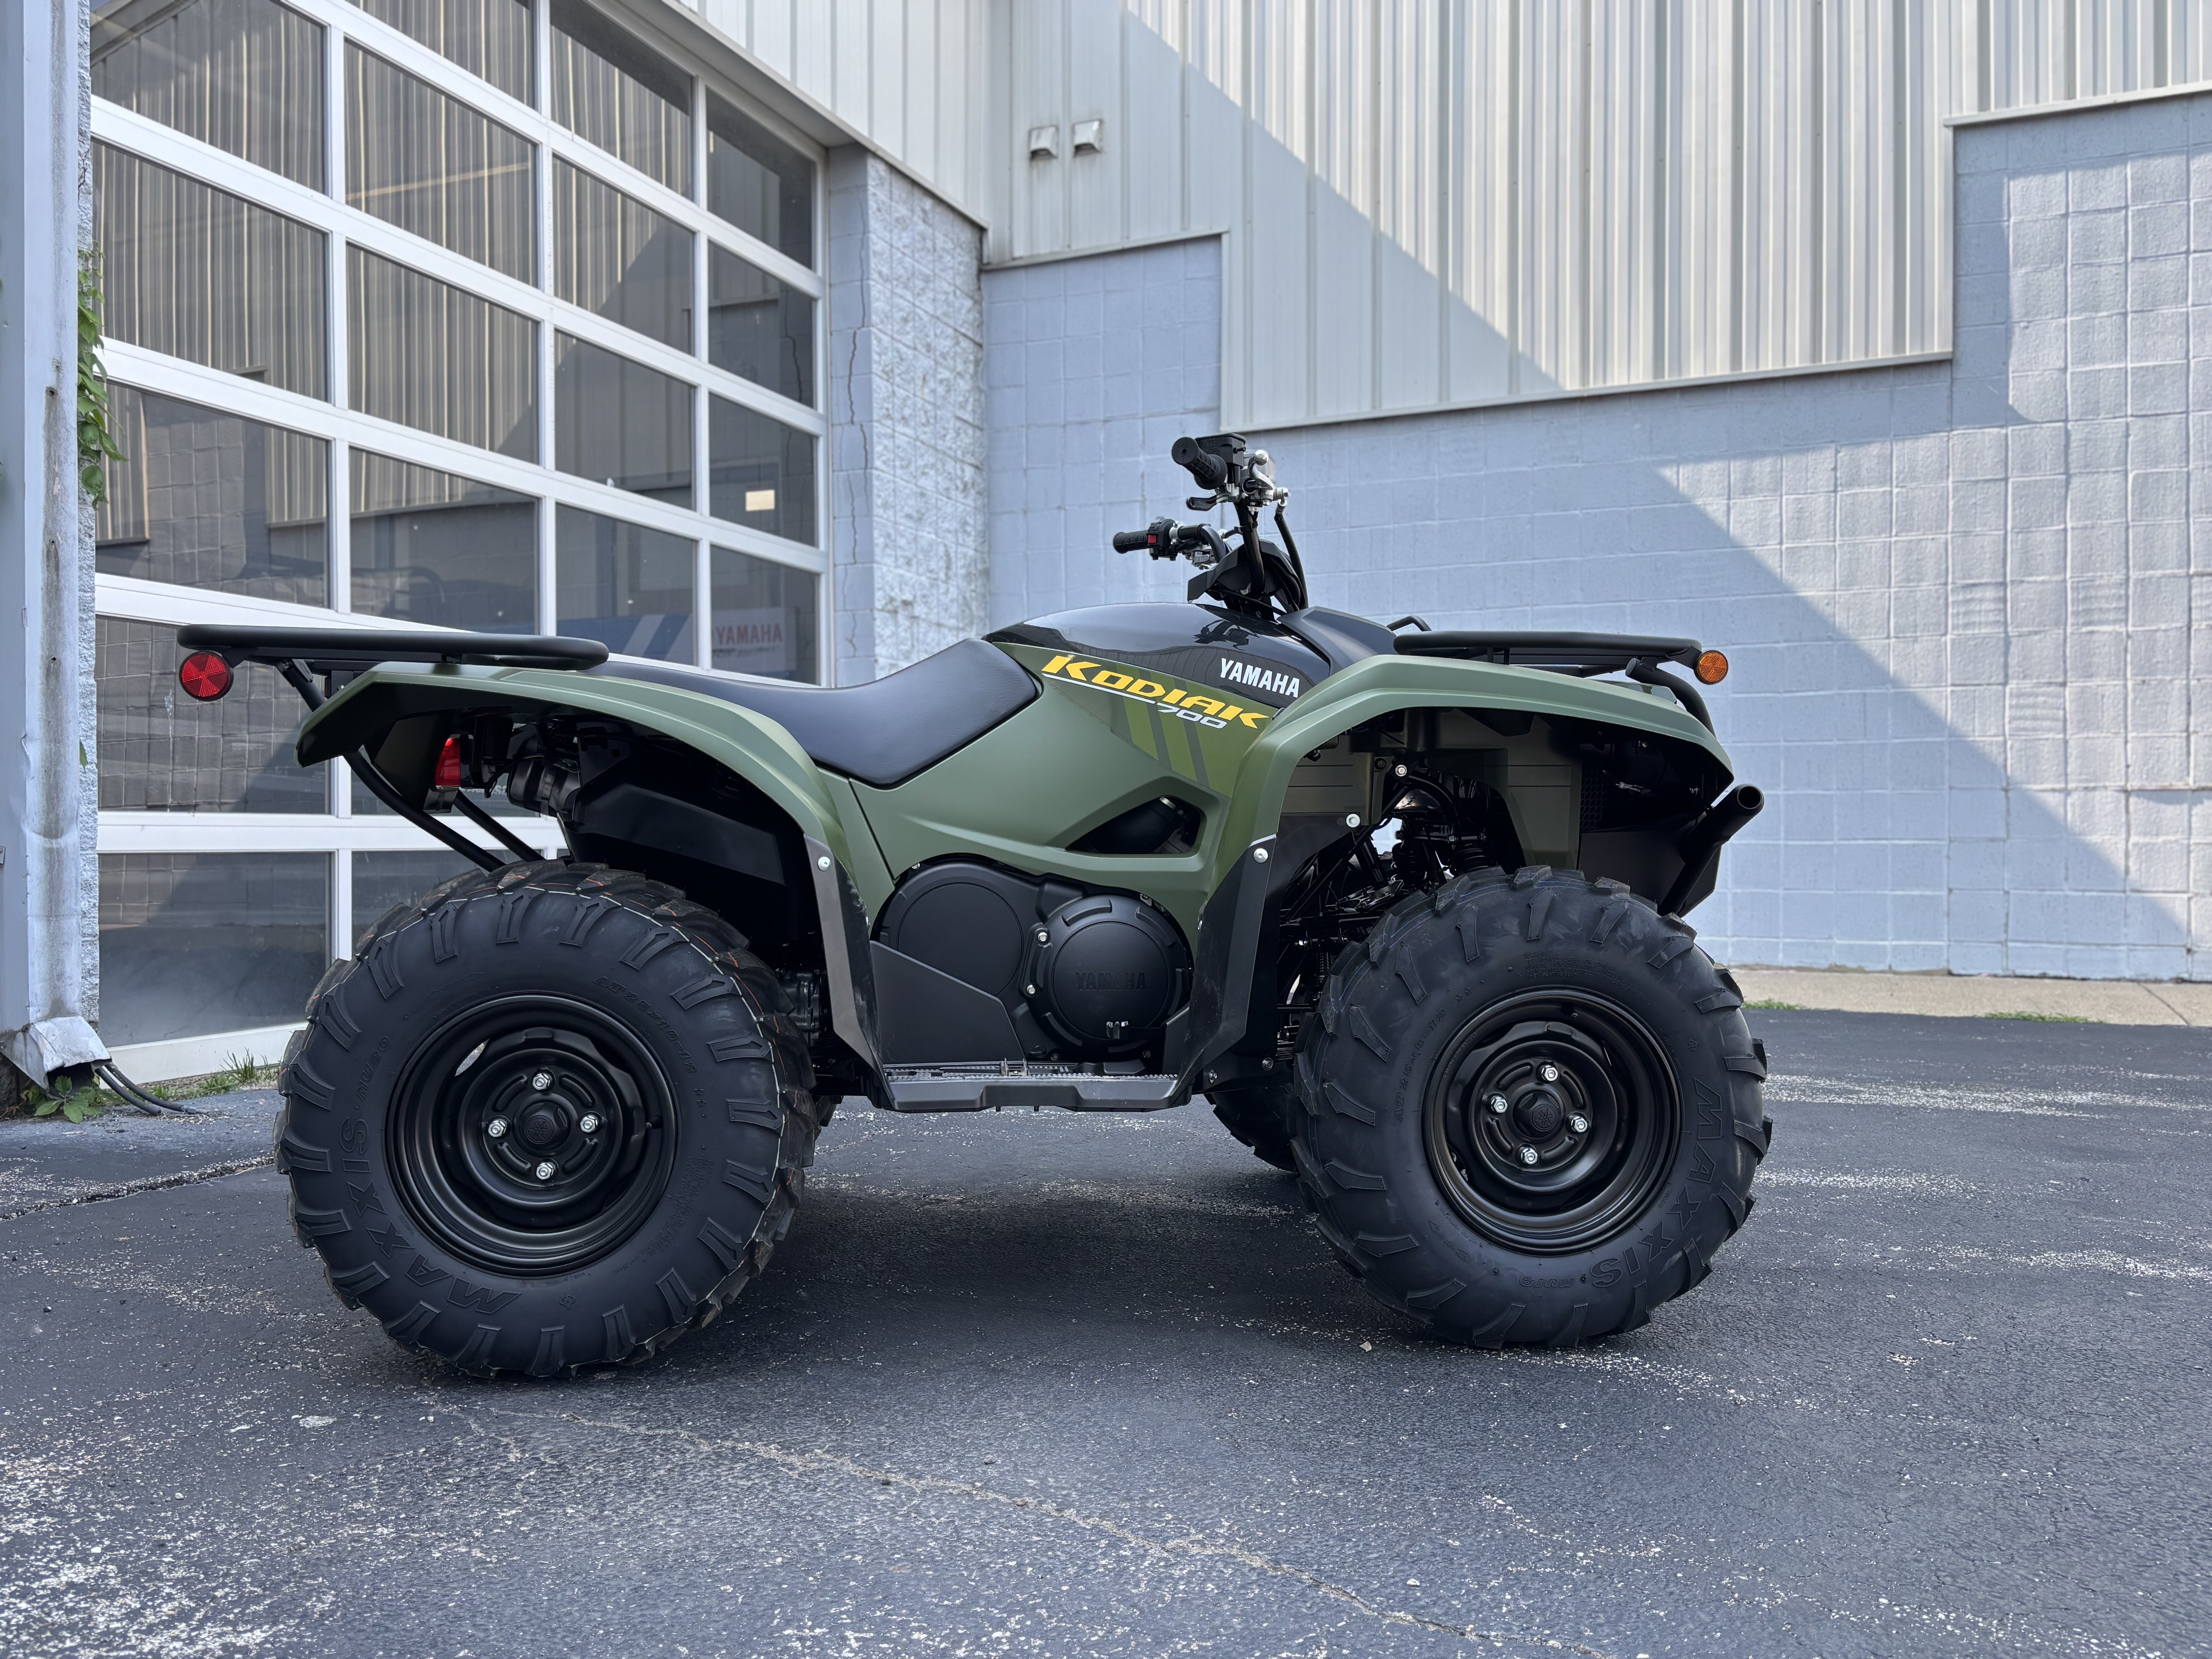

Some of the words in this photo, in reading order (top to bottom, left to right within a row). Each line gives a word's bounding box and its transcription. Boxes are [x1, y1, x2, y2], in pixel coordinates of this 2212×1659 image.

[716, 623, 782, 645] YAMAHA
[1042, 655, 1270, 729] KODIAK
[1220, 658, 1300, 698] YAMAHA
[1157, 702, 1227, 729] 700
[1075, 972, 1147, 991] YAMAHA
[1589, 1077, 1724, 1288] MAXXIS
[339, 1117, 522, 1314] MAXXIS
